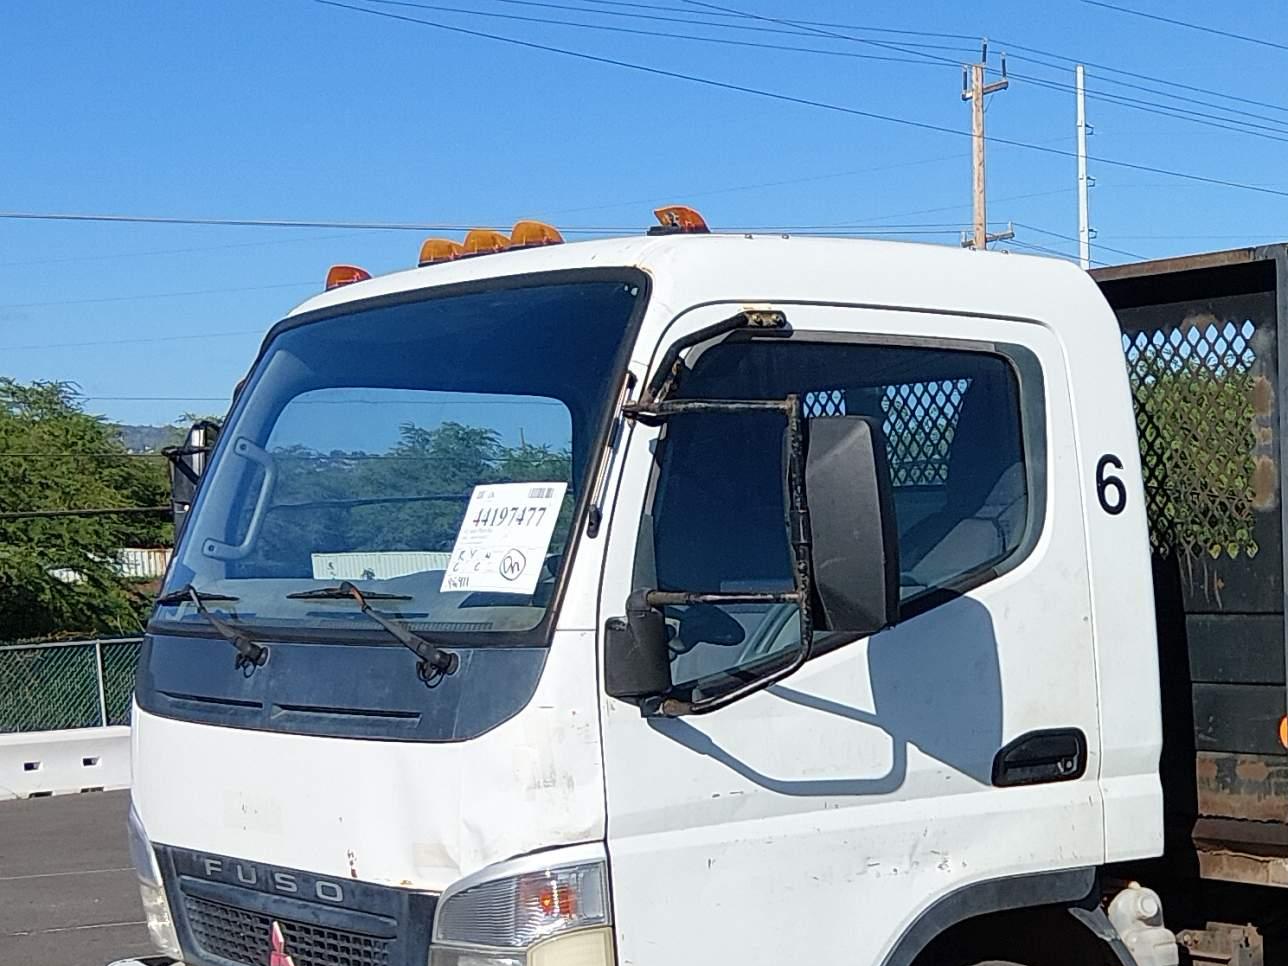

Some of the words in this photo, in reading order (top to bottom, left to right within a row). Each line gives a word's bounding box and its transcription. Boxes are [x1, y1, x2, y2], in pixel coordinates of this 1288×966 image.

[1095, 453, 1127, 515] 6
[473, 506, 547, 527] 44197477
[203, 858, 344, 902] FUSO
